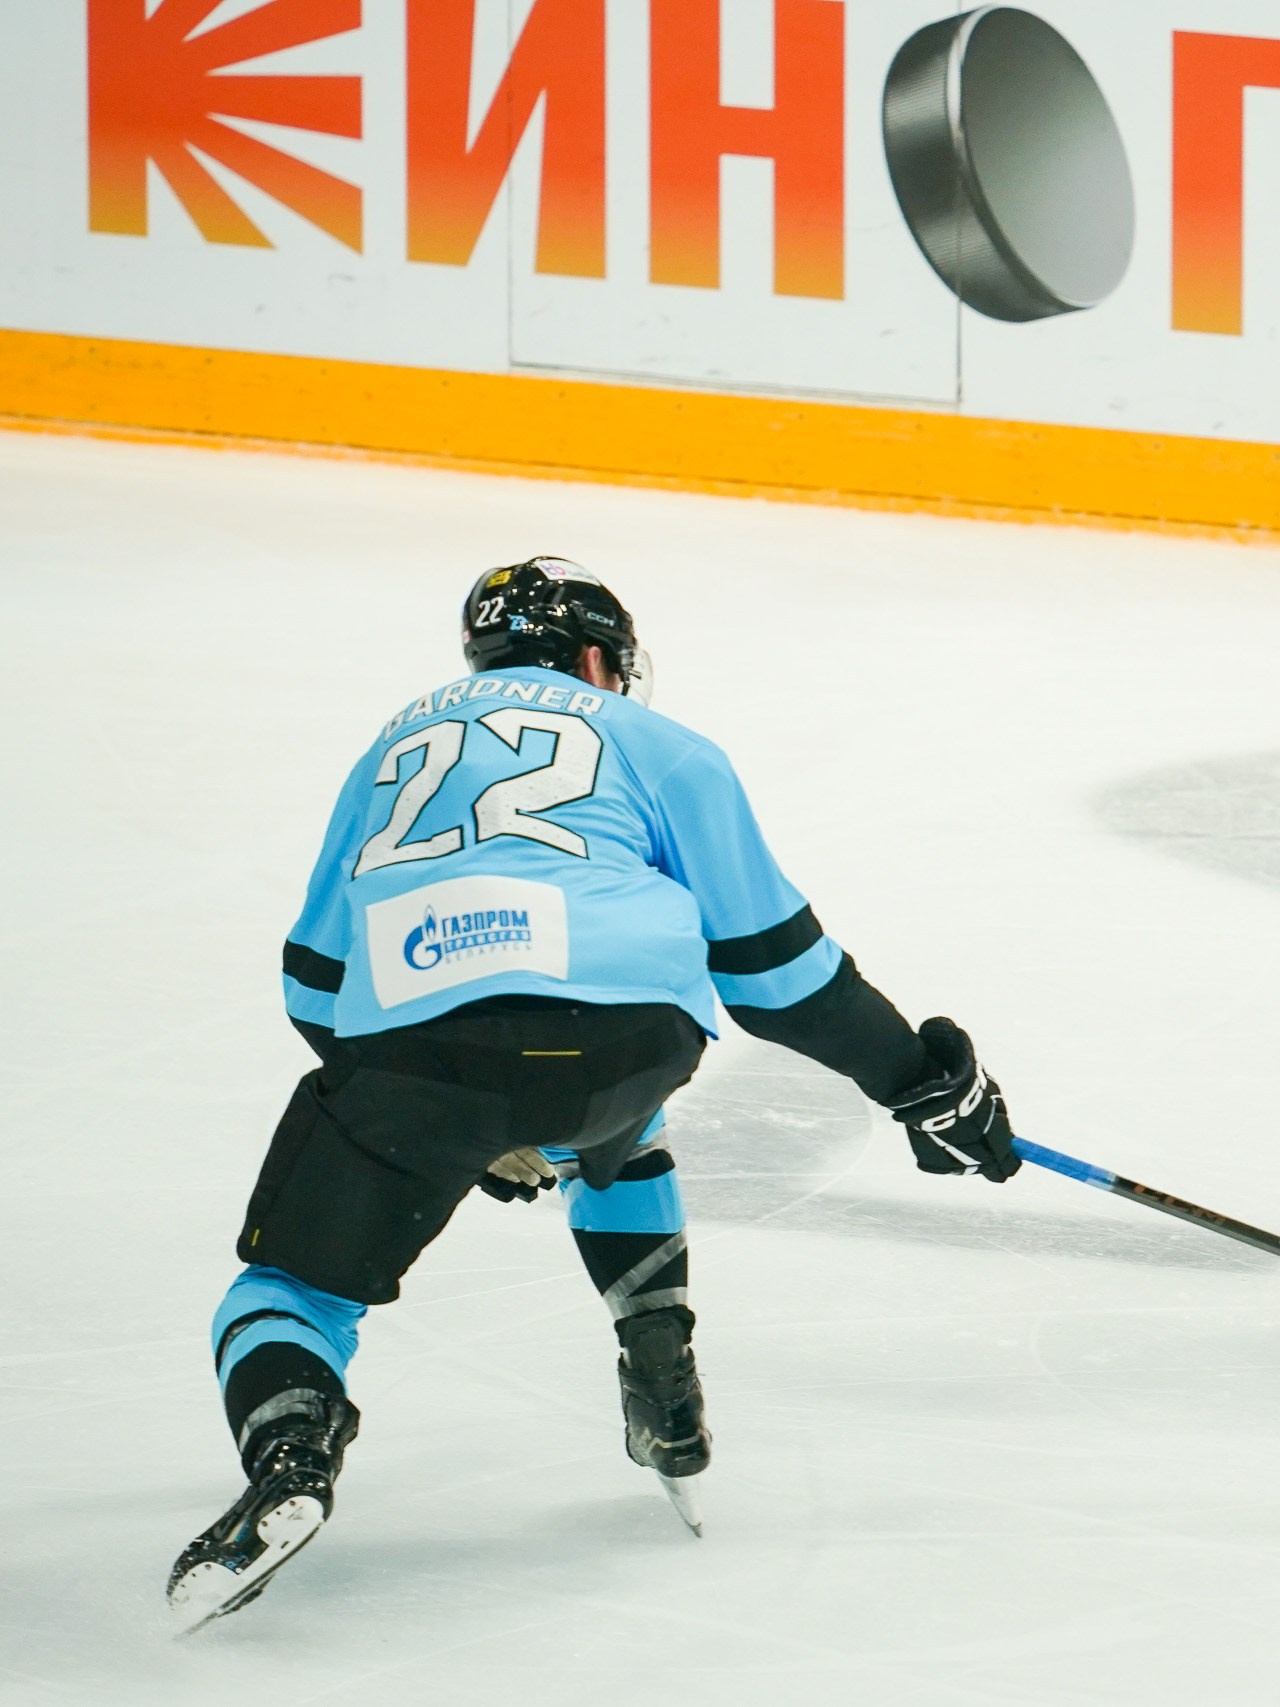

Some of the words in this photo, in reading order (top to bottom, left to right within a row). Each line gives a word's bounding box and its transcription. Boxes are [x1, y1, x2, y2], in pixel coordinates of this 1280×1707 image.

[475, 596, 506, 628] 22
[384, 678, 605, 742] GARDNER
[352, 706, 604, 881] 22
[441, 909, 530, 938] ГАЗПРОМ
